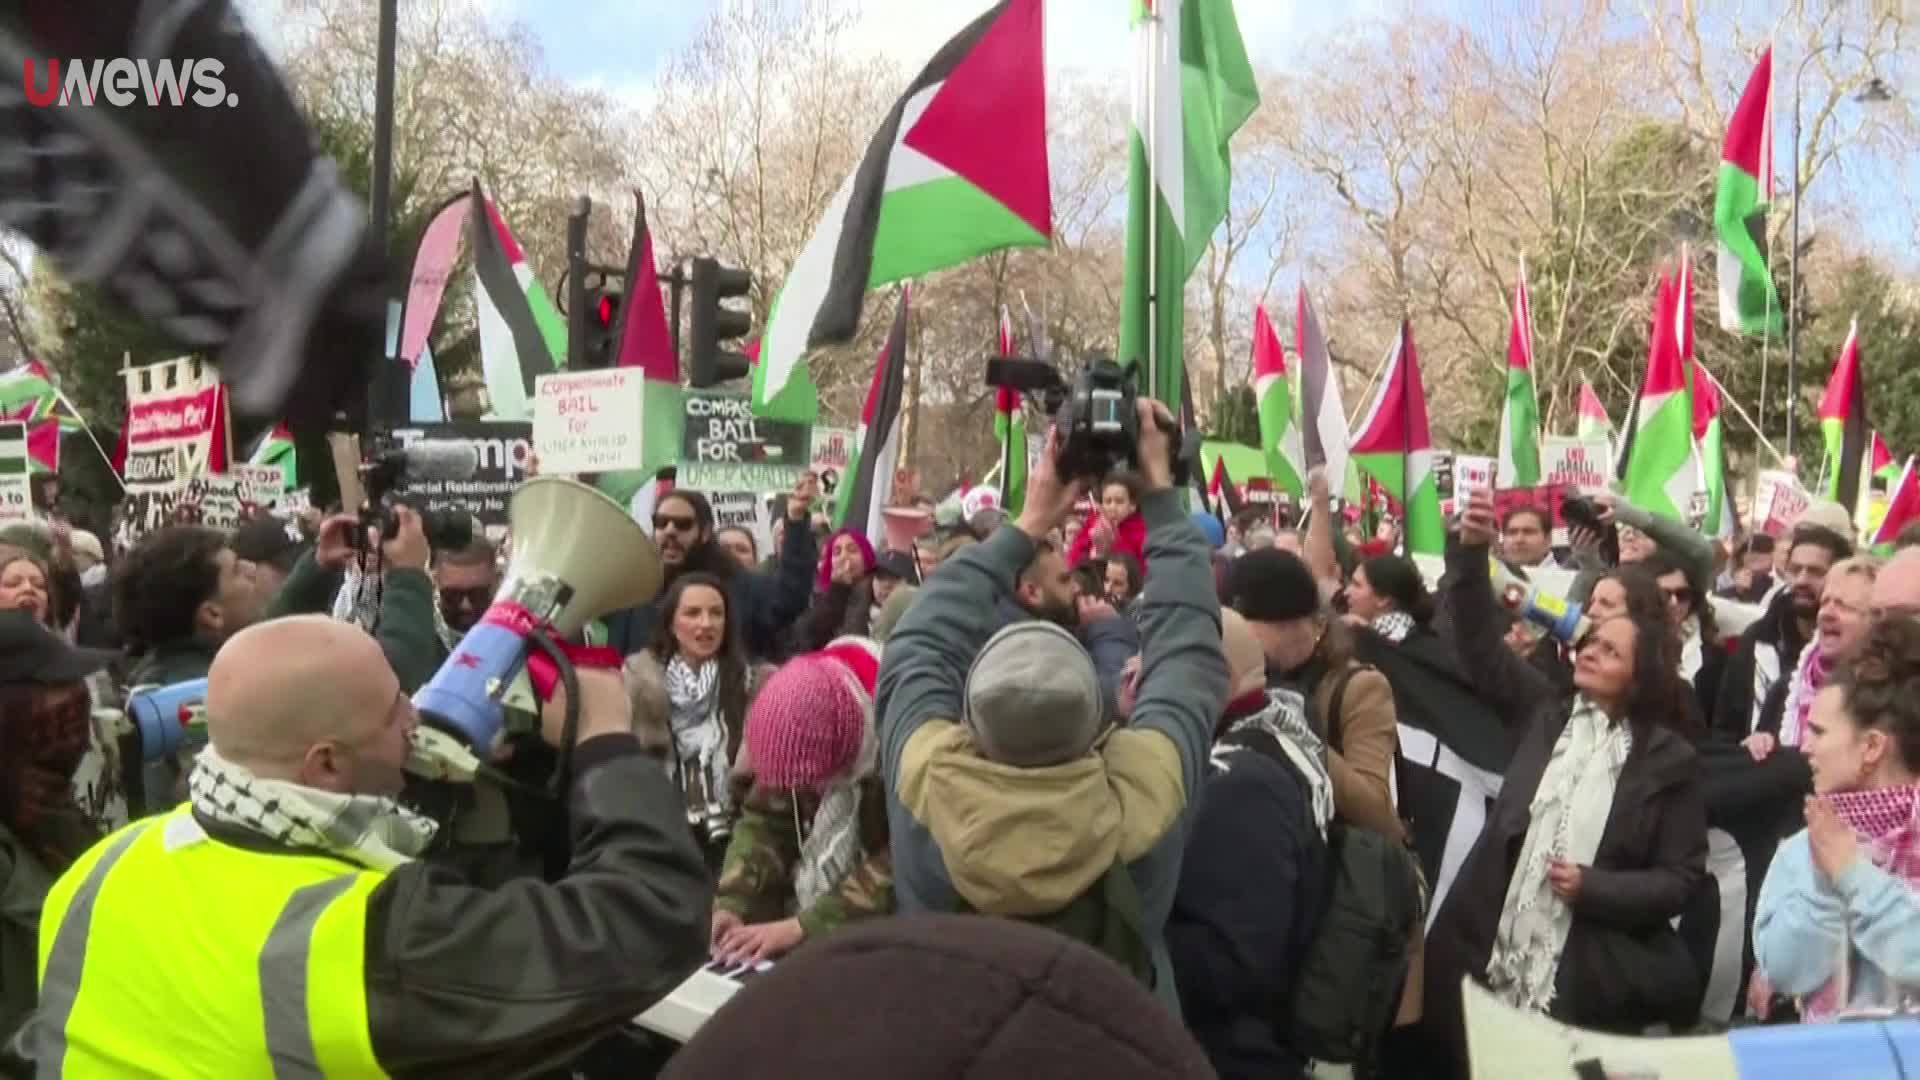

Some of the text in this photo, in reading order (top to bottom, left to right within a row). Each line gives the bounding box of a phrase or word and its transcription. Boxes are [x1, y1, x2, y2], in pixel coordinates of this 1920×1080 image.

[558, 395, 599, 415] BAIL
[709, 419, 765, 442] BAIL
[697, 439, 741, 463] FOR
